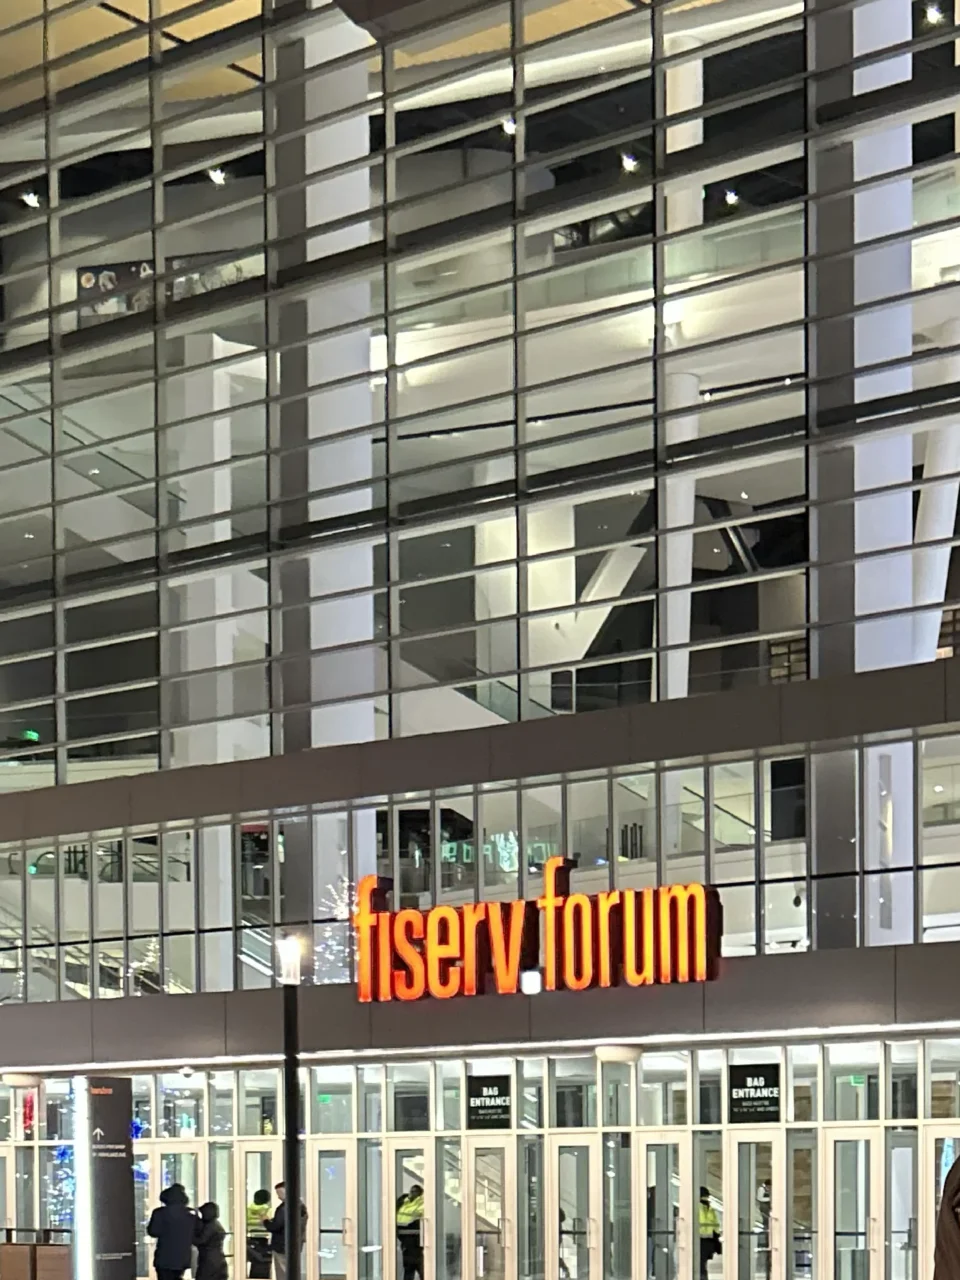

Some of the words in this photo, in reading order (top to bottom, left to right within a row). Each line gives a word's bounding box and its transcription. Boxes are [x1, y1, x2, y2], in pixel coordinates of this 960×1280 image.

[746, 1077, 765, 1087] BAG
[482, 1087, 499, 1096] BAG
[732, 1087, 780, 1098] ENTRANCE
[470, 1097, 511, 1107] ENTRANCE
